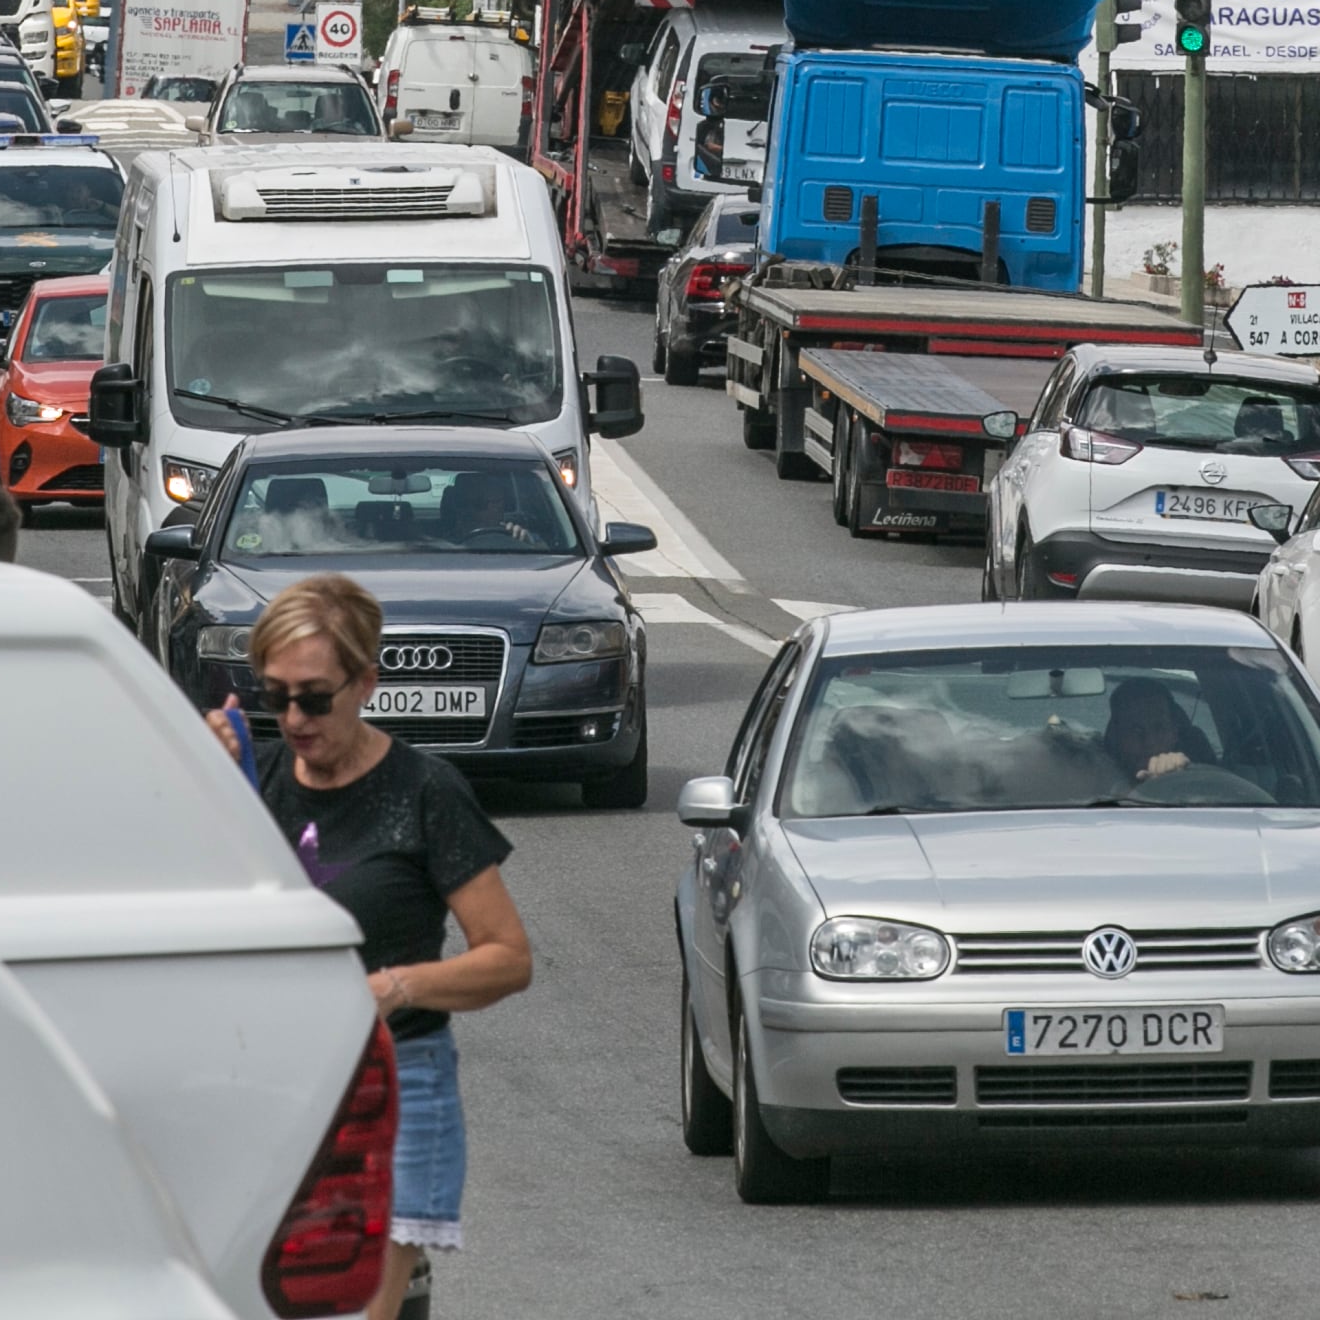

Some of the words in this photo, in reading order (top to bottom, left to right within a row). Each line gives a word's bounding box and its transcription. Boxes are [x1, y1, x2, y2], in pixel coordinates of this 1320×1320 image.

[171, 7, 220, 21] transportes
[330, 23, 350, 35] 40
[1154, 43, 1177, 57] SA
[1209, 44, 1251, 57] FAEL
[1266, 45, 1318, 58] DESDE
[907, 81, 964, 97] IVECO
[734, 167, 756, 179] LNX
[1249, 331, 1270, 346] 547
[1280, 330, 1288, 345] A
[1169, 495, 1216, 515] 2496
[1223, 500, 1258, 517] KF
[872, 507, 937, 527] Leciñena
[434, 690, 478, 713] DMP
[1032, 1013, 1129, 1050] 7270
[1142, 1011, 1214, 1047] DCR
